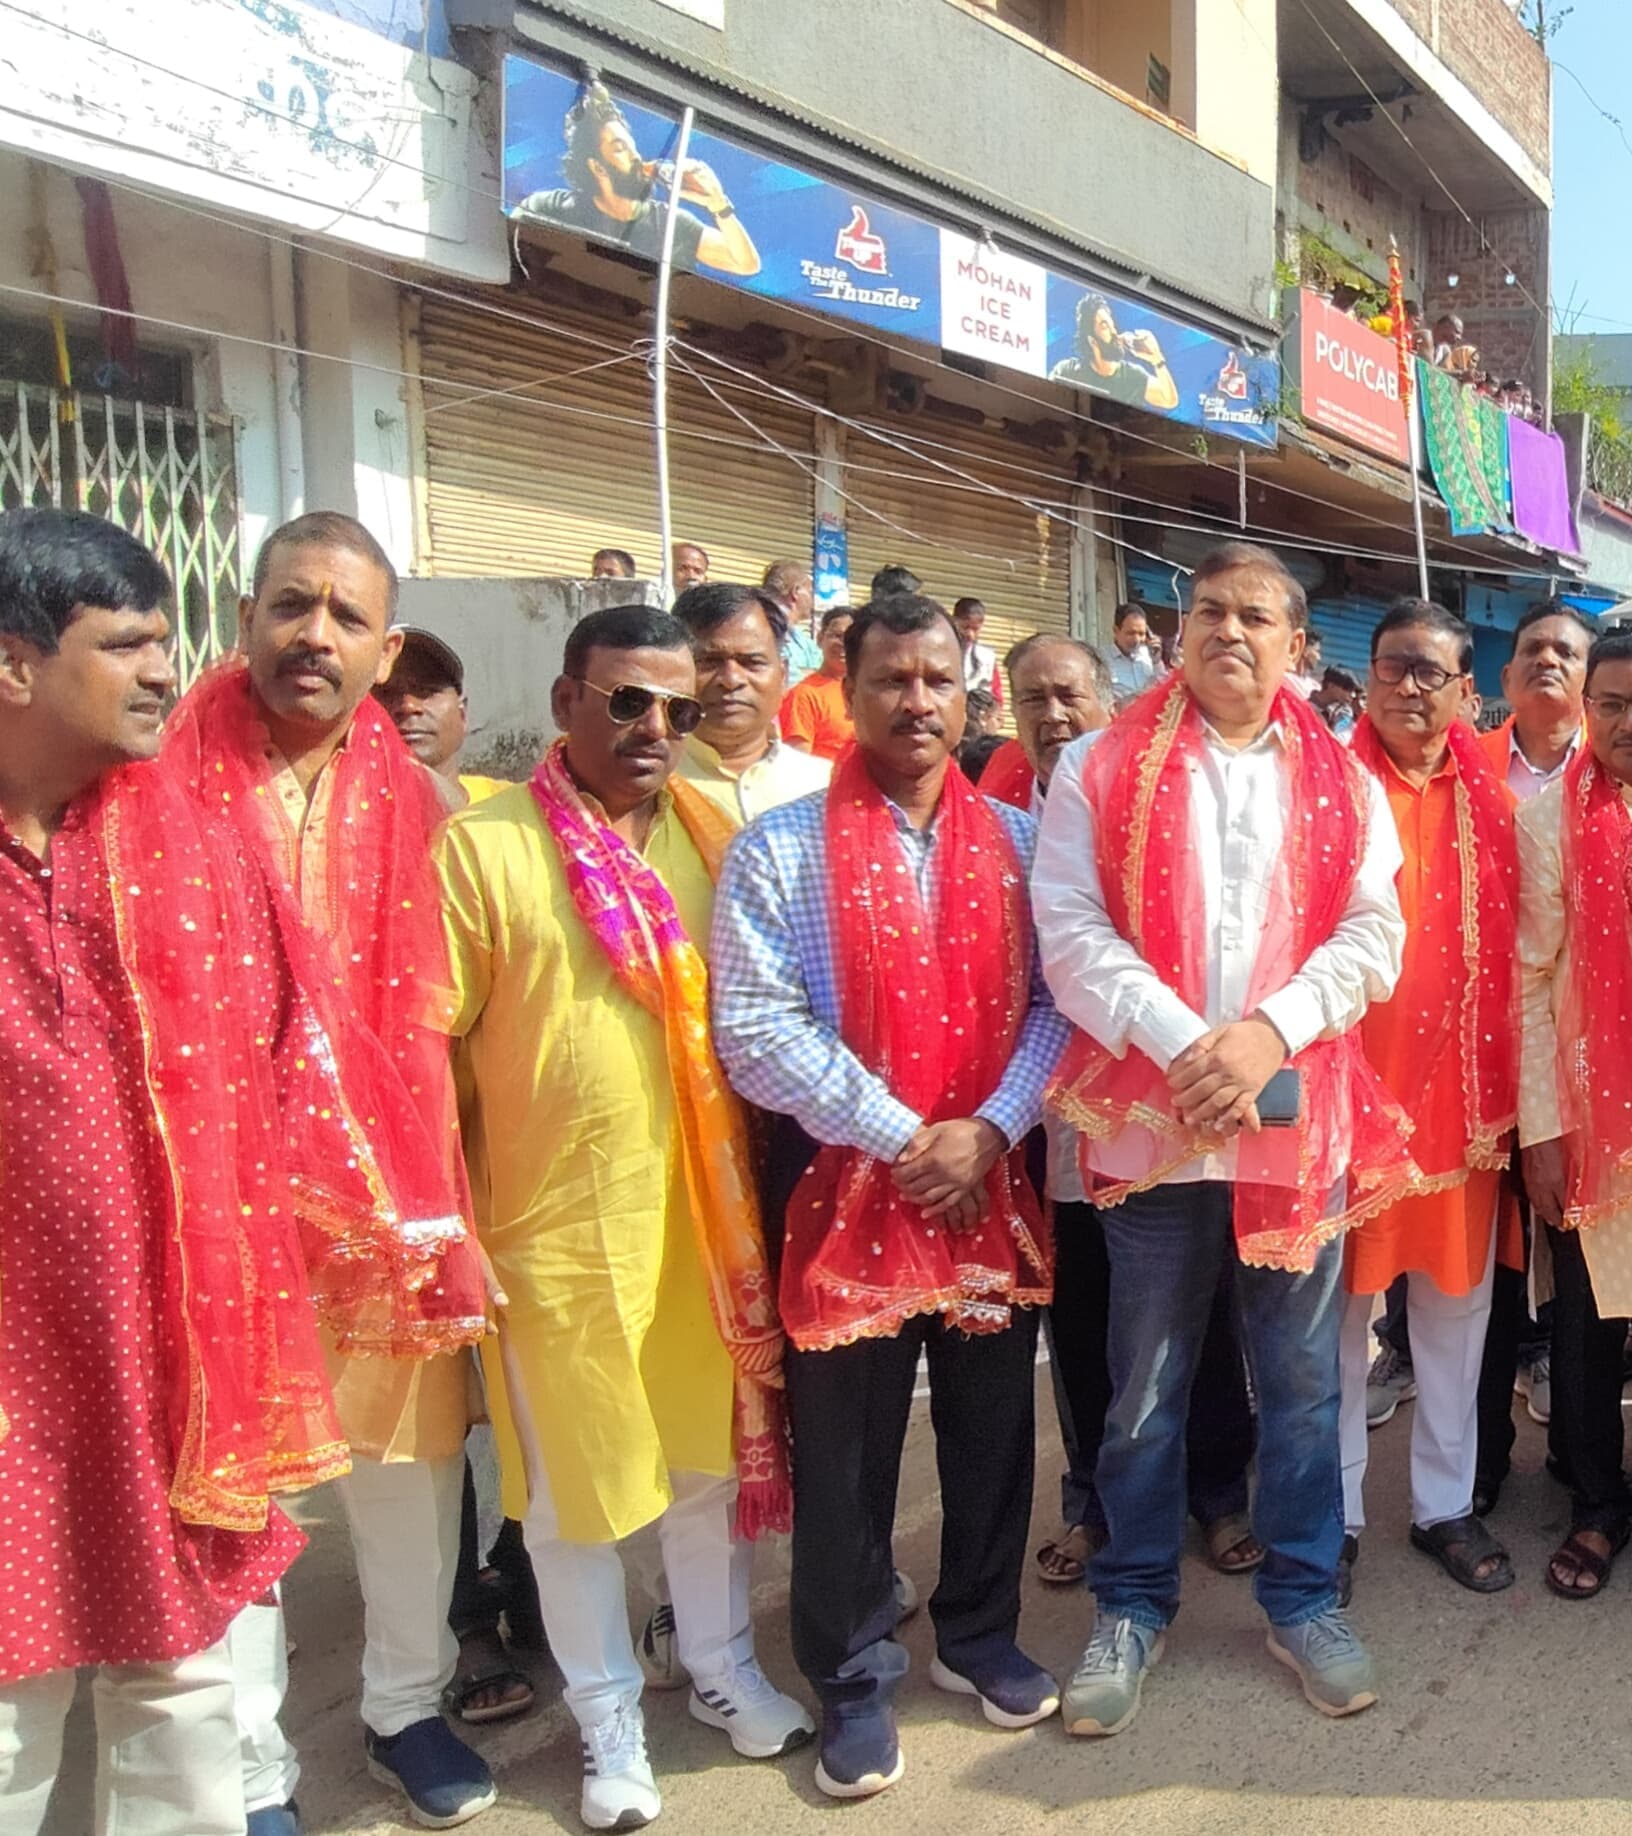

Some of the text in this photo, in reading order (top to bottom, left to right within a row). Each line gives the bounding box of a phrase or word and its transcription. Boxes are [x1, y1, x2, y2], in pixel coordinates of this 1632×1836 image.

[800, 259, 848, 281] Taste
[957, 260, 1032, 300] MOHAN
[815, 280, 921, 311] Thunder
[981, 295, 1012, 320] ICE
[961, 316, 1030, 352] CREAM
[1315, 331, 1400, 402] POLYCAB
